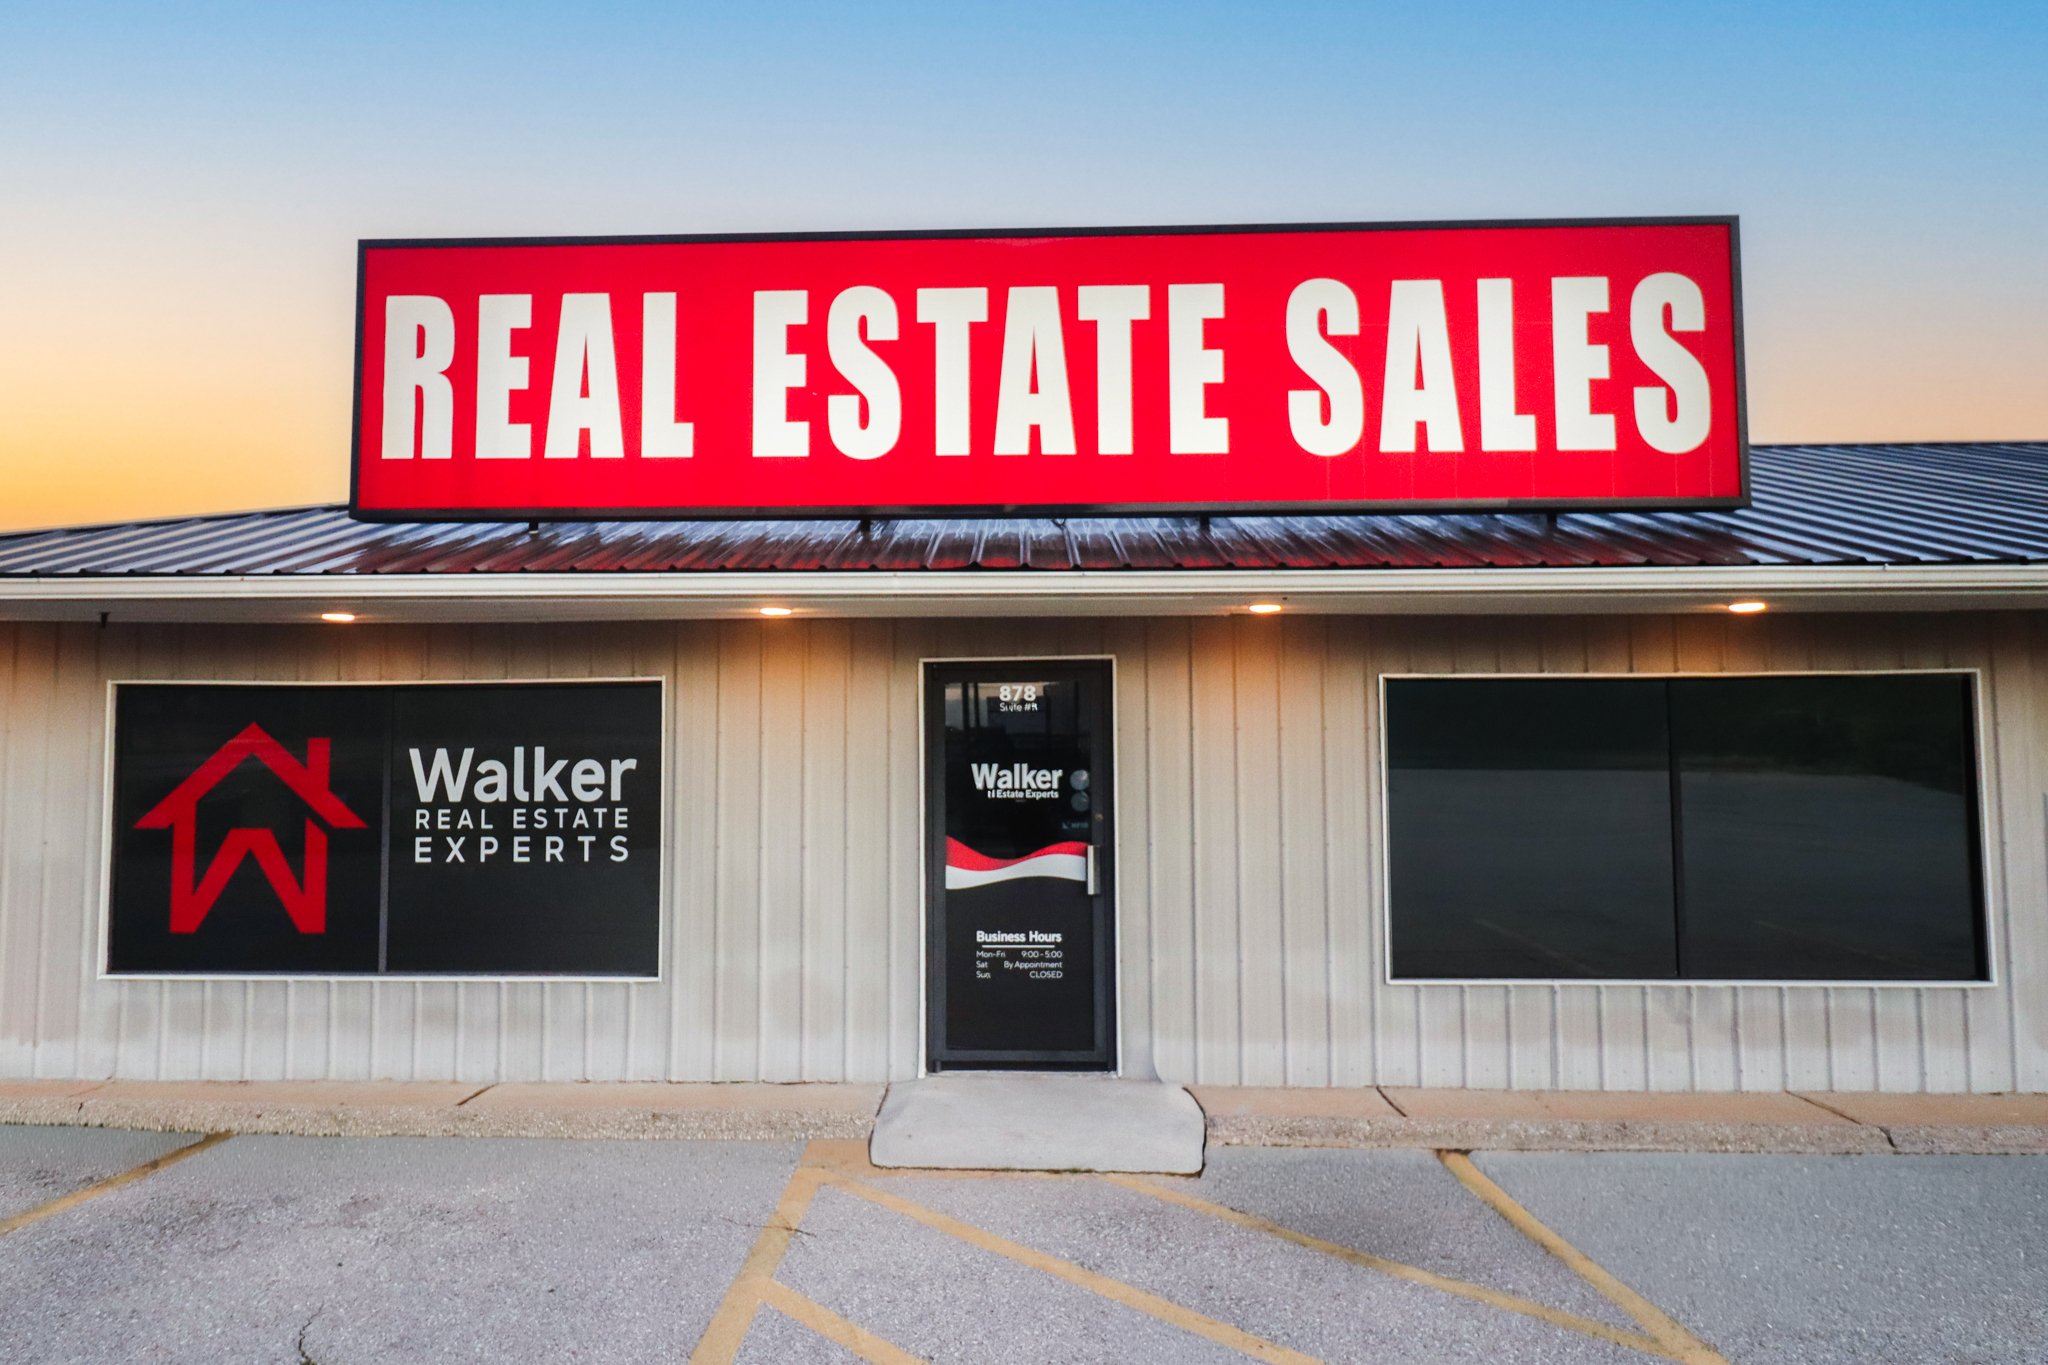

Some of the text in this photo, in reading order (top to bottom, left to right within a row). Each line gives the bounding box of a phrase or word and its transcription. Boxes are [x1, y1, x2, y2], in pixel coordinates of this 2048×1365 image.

[382, 273, 1710, 460] REAL ESTATE SALES
[1000, 685, 1036, 702] 878
[409, 747, 637, 802] Walker
[972, 764, 1062, 789] Walker
[997, 790, 1024, 799] Estate
[1025, 790, 1060, 801] Experts
[416, 808, 628, 829] REAL ESTATE
[415, 836, 628, 862] EXPERTS
[977, 931, 1062, 942] Business Hours
[1004, 961, 1013, 969] By
[1014, 961, 1062, 969] Appointment
